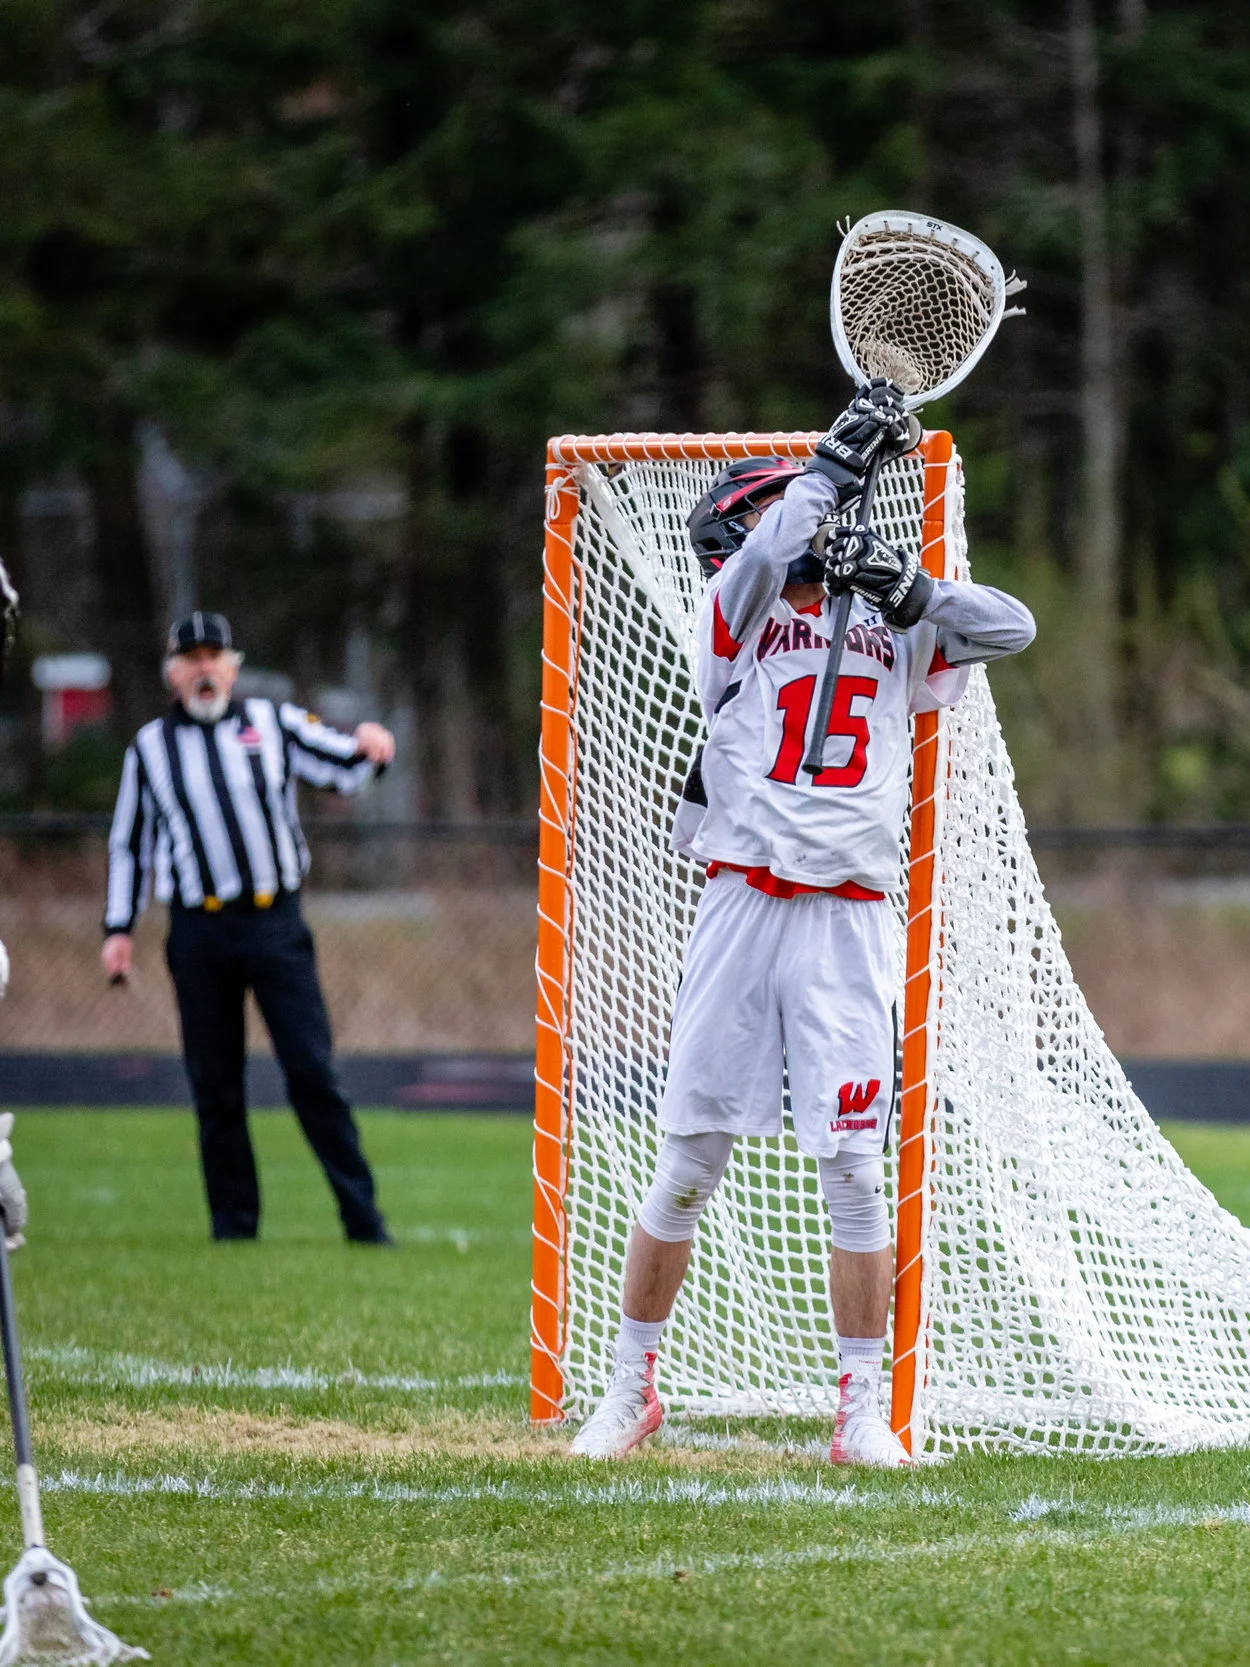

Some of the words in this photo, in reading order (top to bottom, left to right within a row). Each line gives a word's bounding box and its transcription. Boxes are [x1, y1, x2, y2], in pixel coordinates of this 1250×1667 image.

[926, 221, 943, 231] STX
[860, 431, 885, 461] BRINE
[849, 584, 882, 604] BRINE
[765, 674, 879, 788] 15
